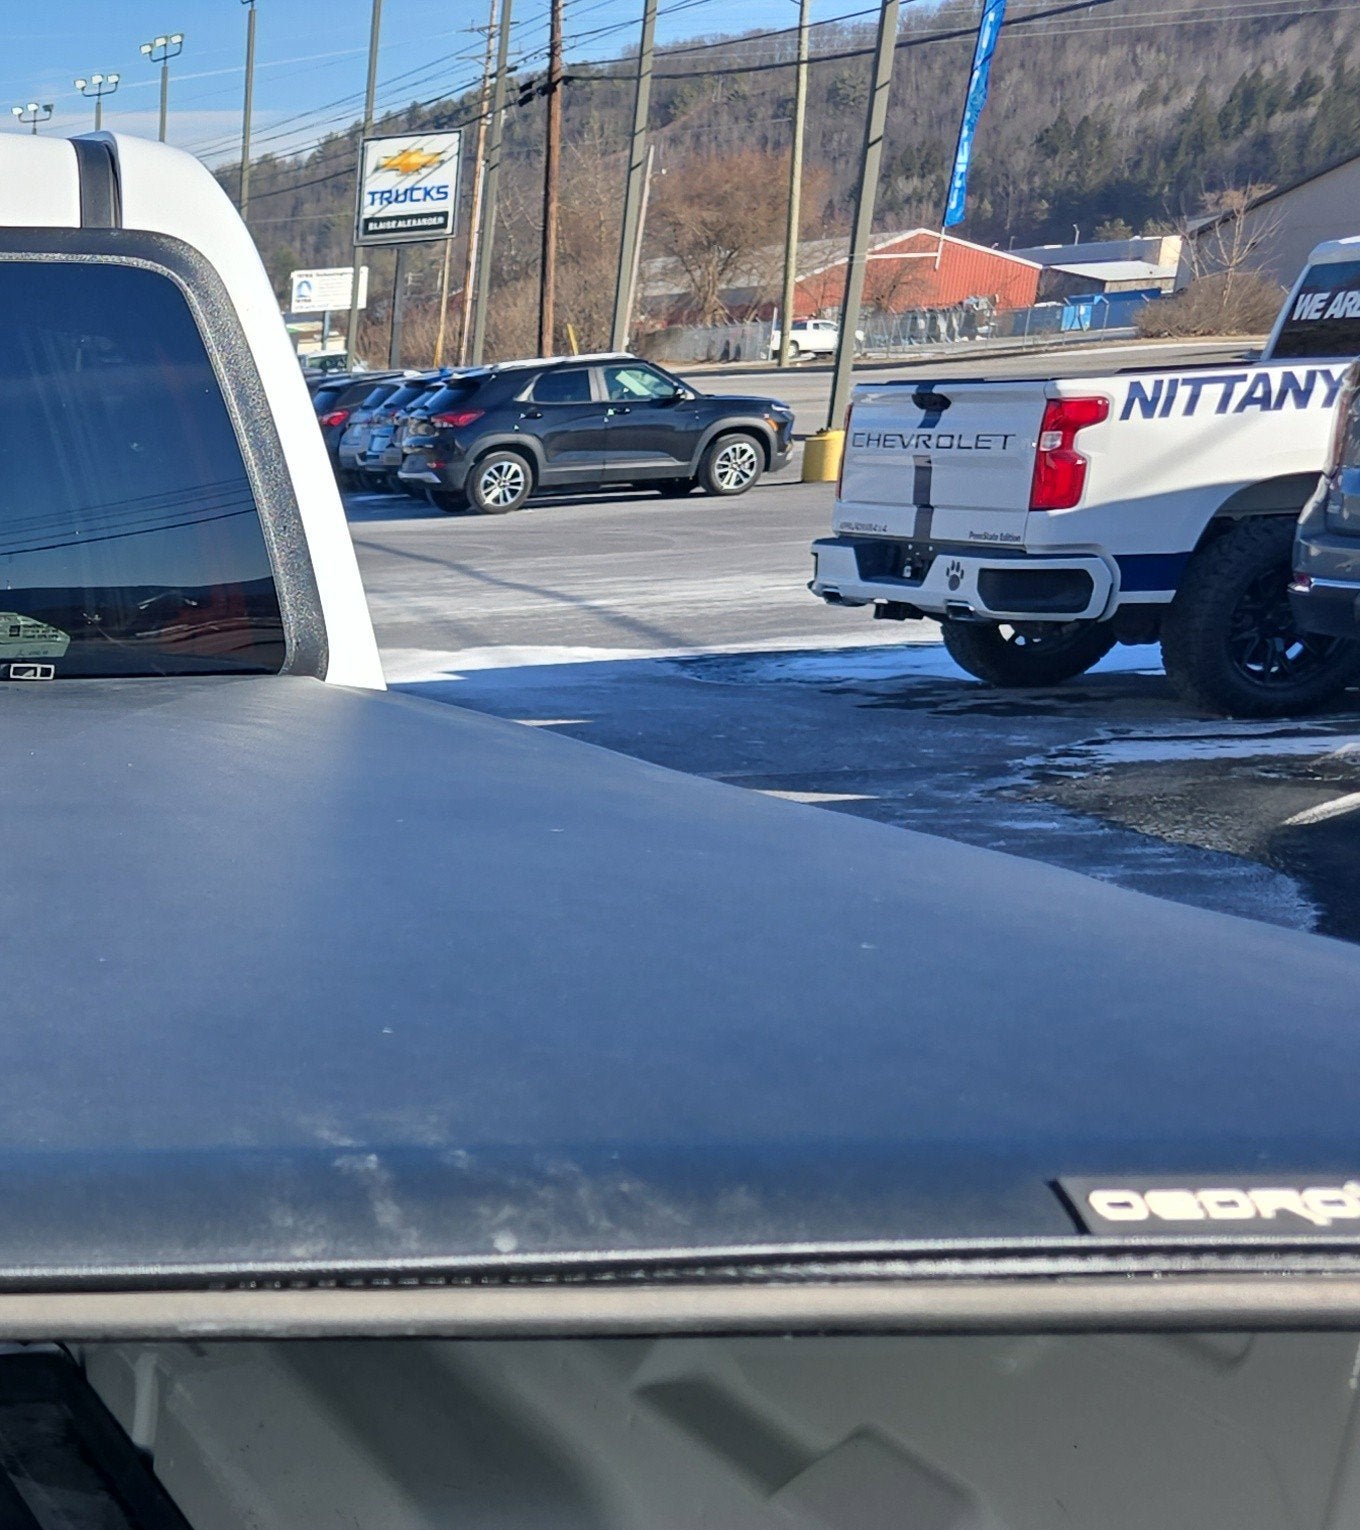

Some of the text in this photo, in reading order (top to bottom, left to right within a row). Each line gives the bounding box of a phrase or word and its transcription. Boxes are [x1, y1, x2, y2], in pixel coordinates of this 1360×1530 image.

[367, 184, 449, 206] TRUCKS
[1292, 291, 1331, 321] WE
[1119, 369, 1347, 421] NITTANY
[852, 432, 1016, 450] CHEVROLET
